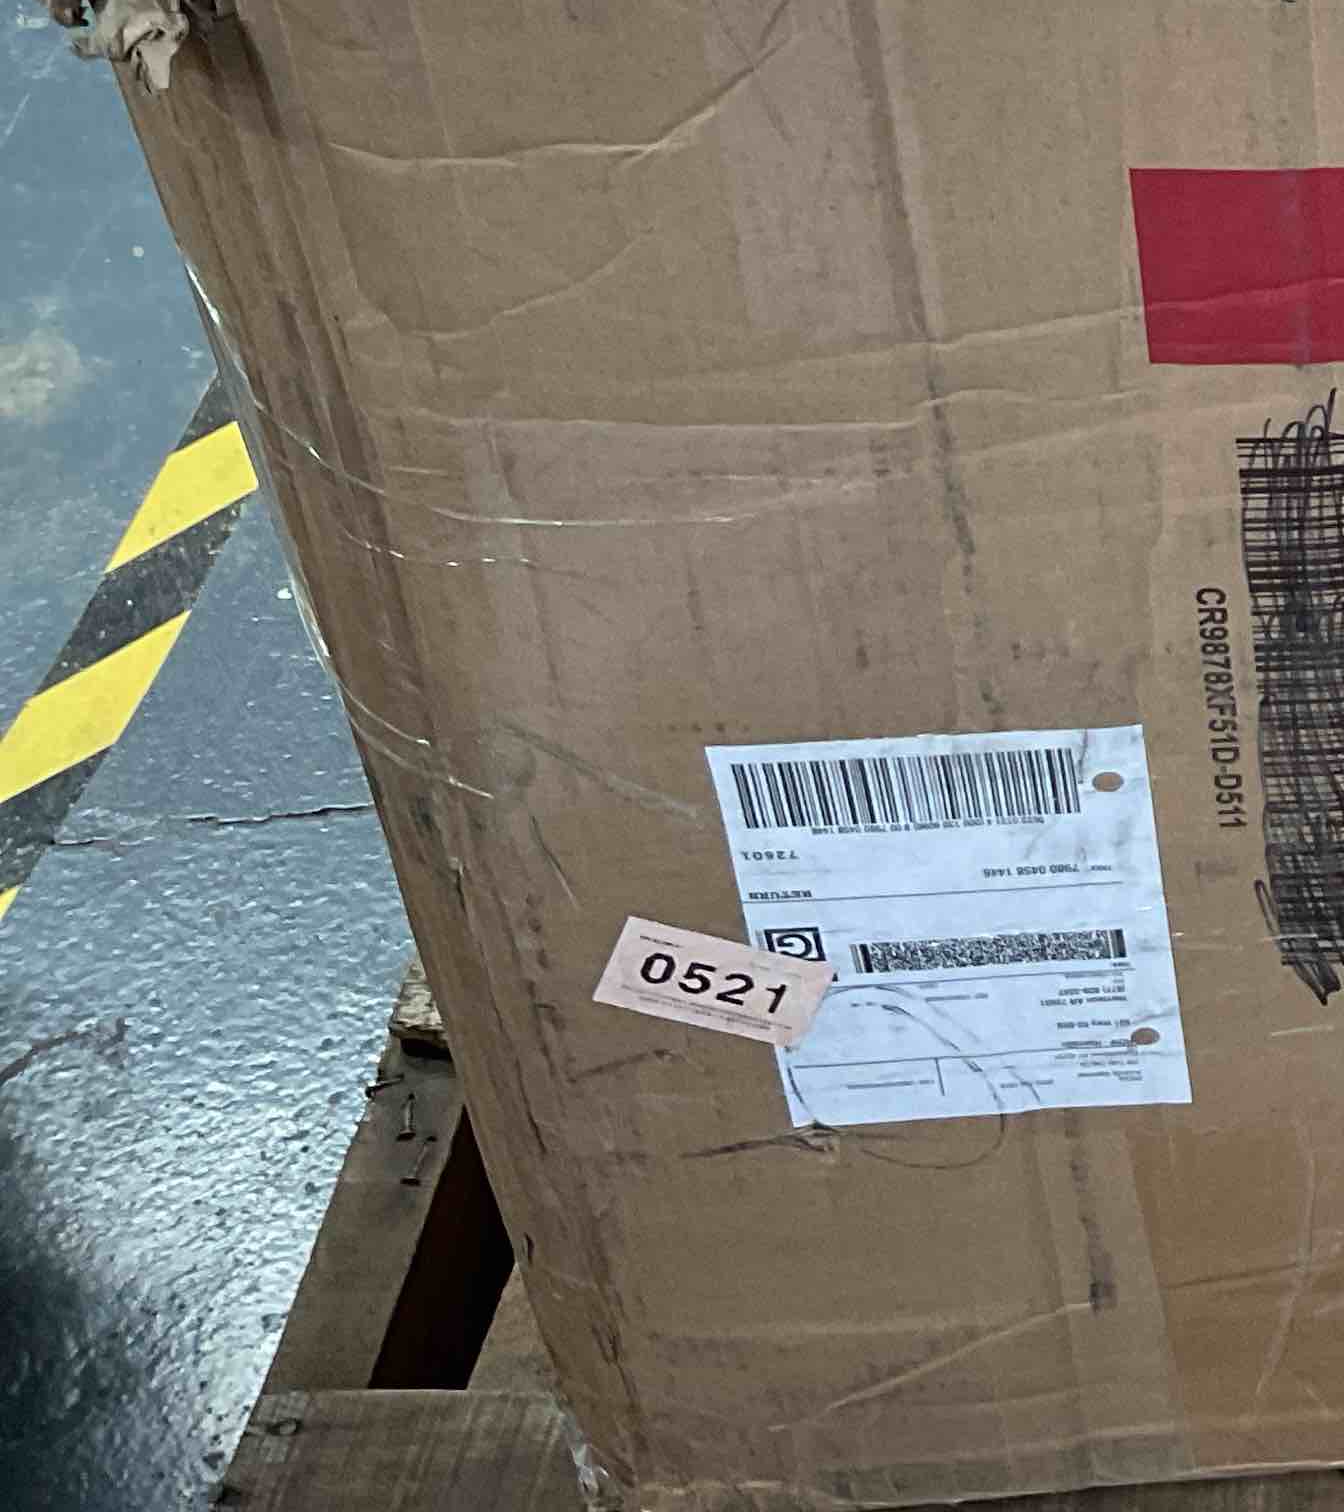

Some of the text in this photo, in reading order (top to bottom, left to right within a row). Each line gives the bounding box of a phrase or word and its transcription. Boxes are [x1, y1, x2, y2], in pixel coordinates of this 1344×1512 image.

[1195, 587, 1248, 829] CR9878XF51D-D511
[747, 889, 812, 901] RETURN
[774, 934, 813, 958] G
[639, 952, 787, 1014] 0521
